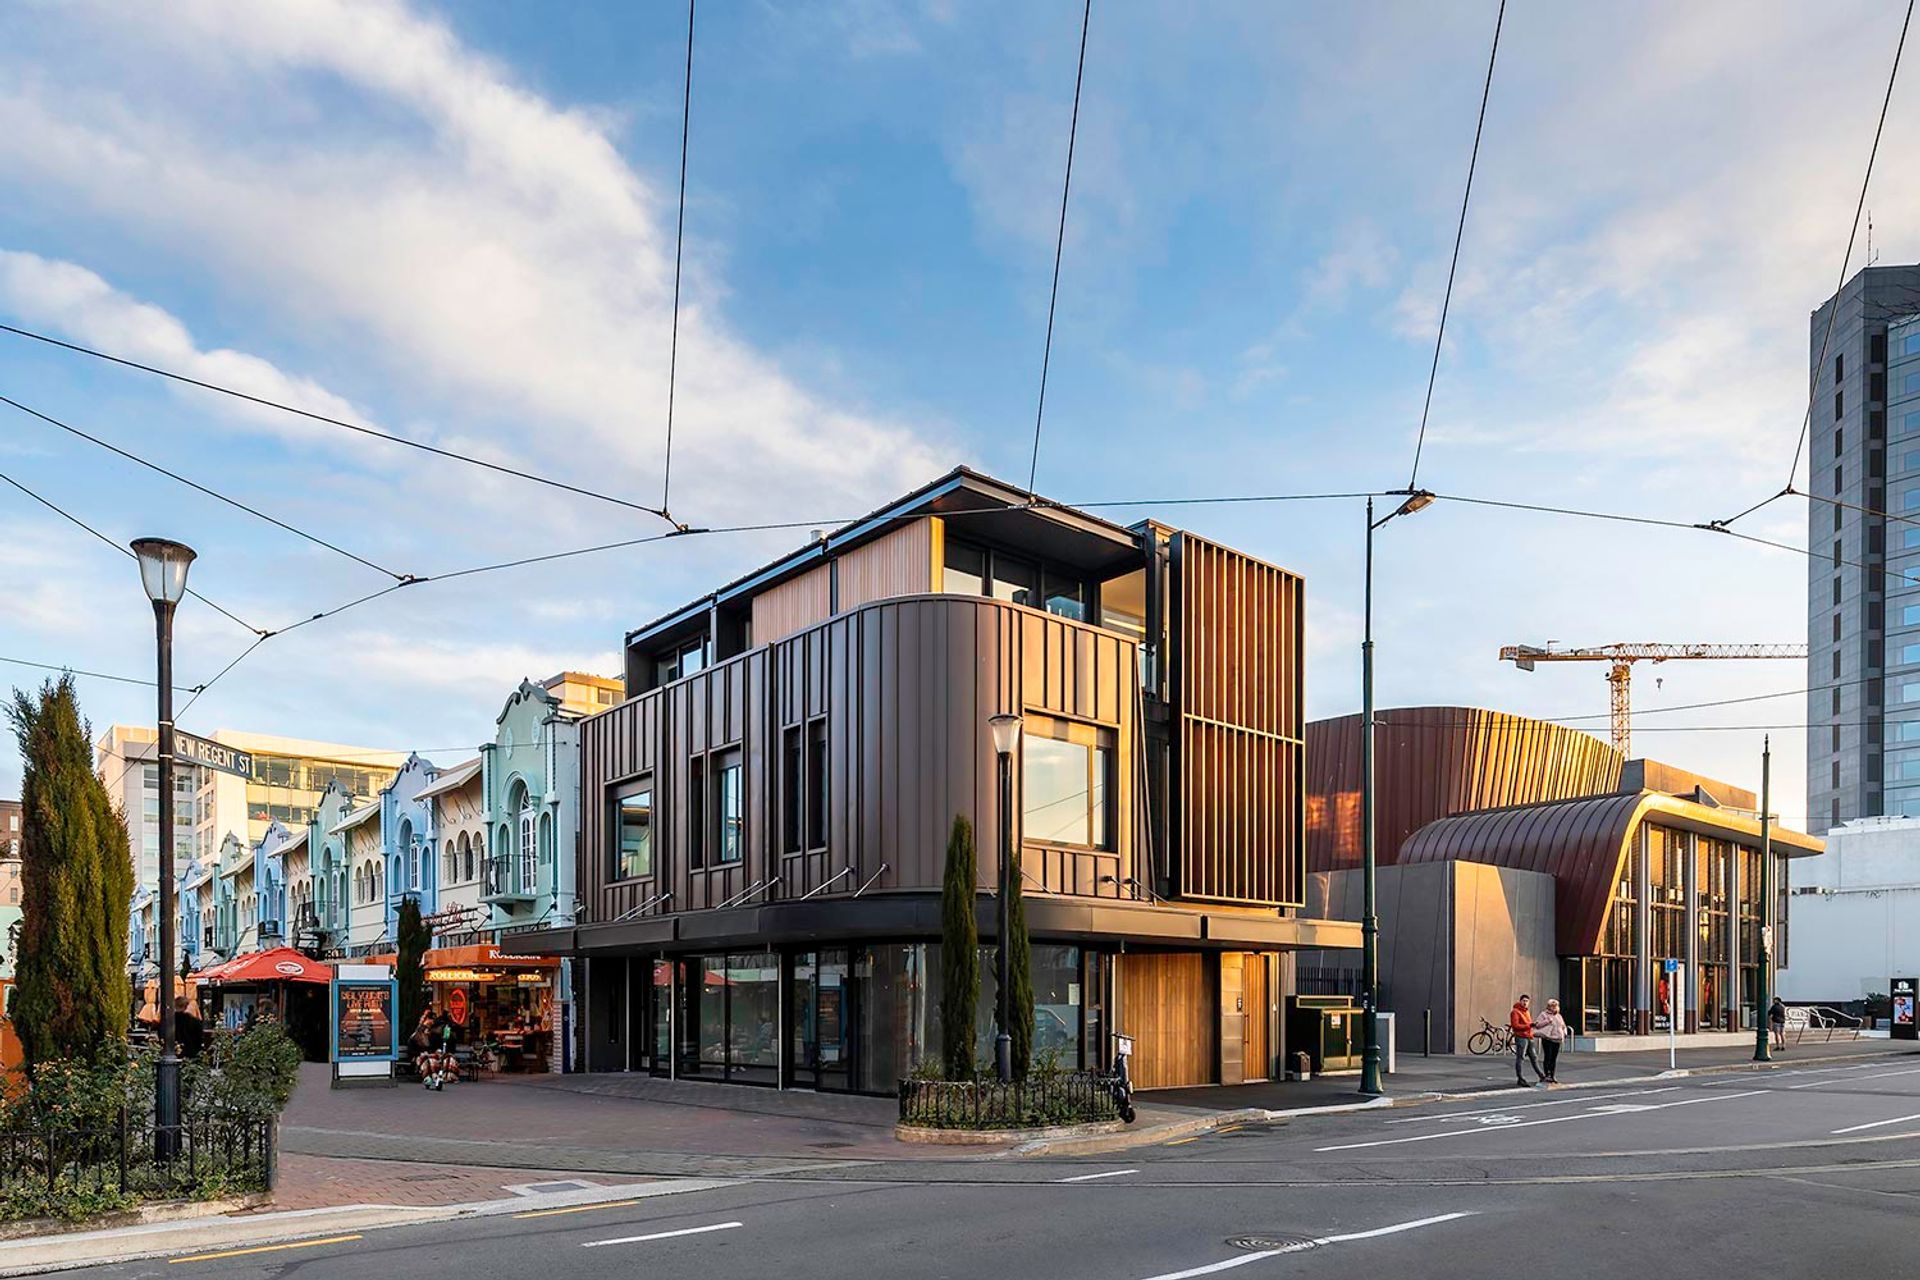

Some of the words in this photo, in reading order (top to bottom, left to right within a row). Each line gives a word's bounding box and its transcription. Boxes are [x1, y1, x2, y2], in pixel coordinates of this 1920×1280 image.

[174, 734, 196, 758] NEW
[198, 742, 236, 769] REGENT
[239, 755, 250, 774] ST
